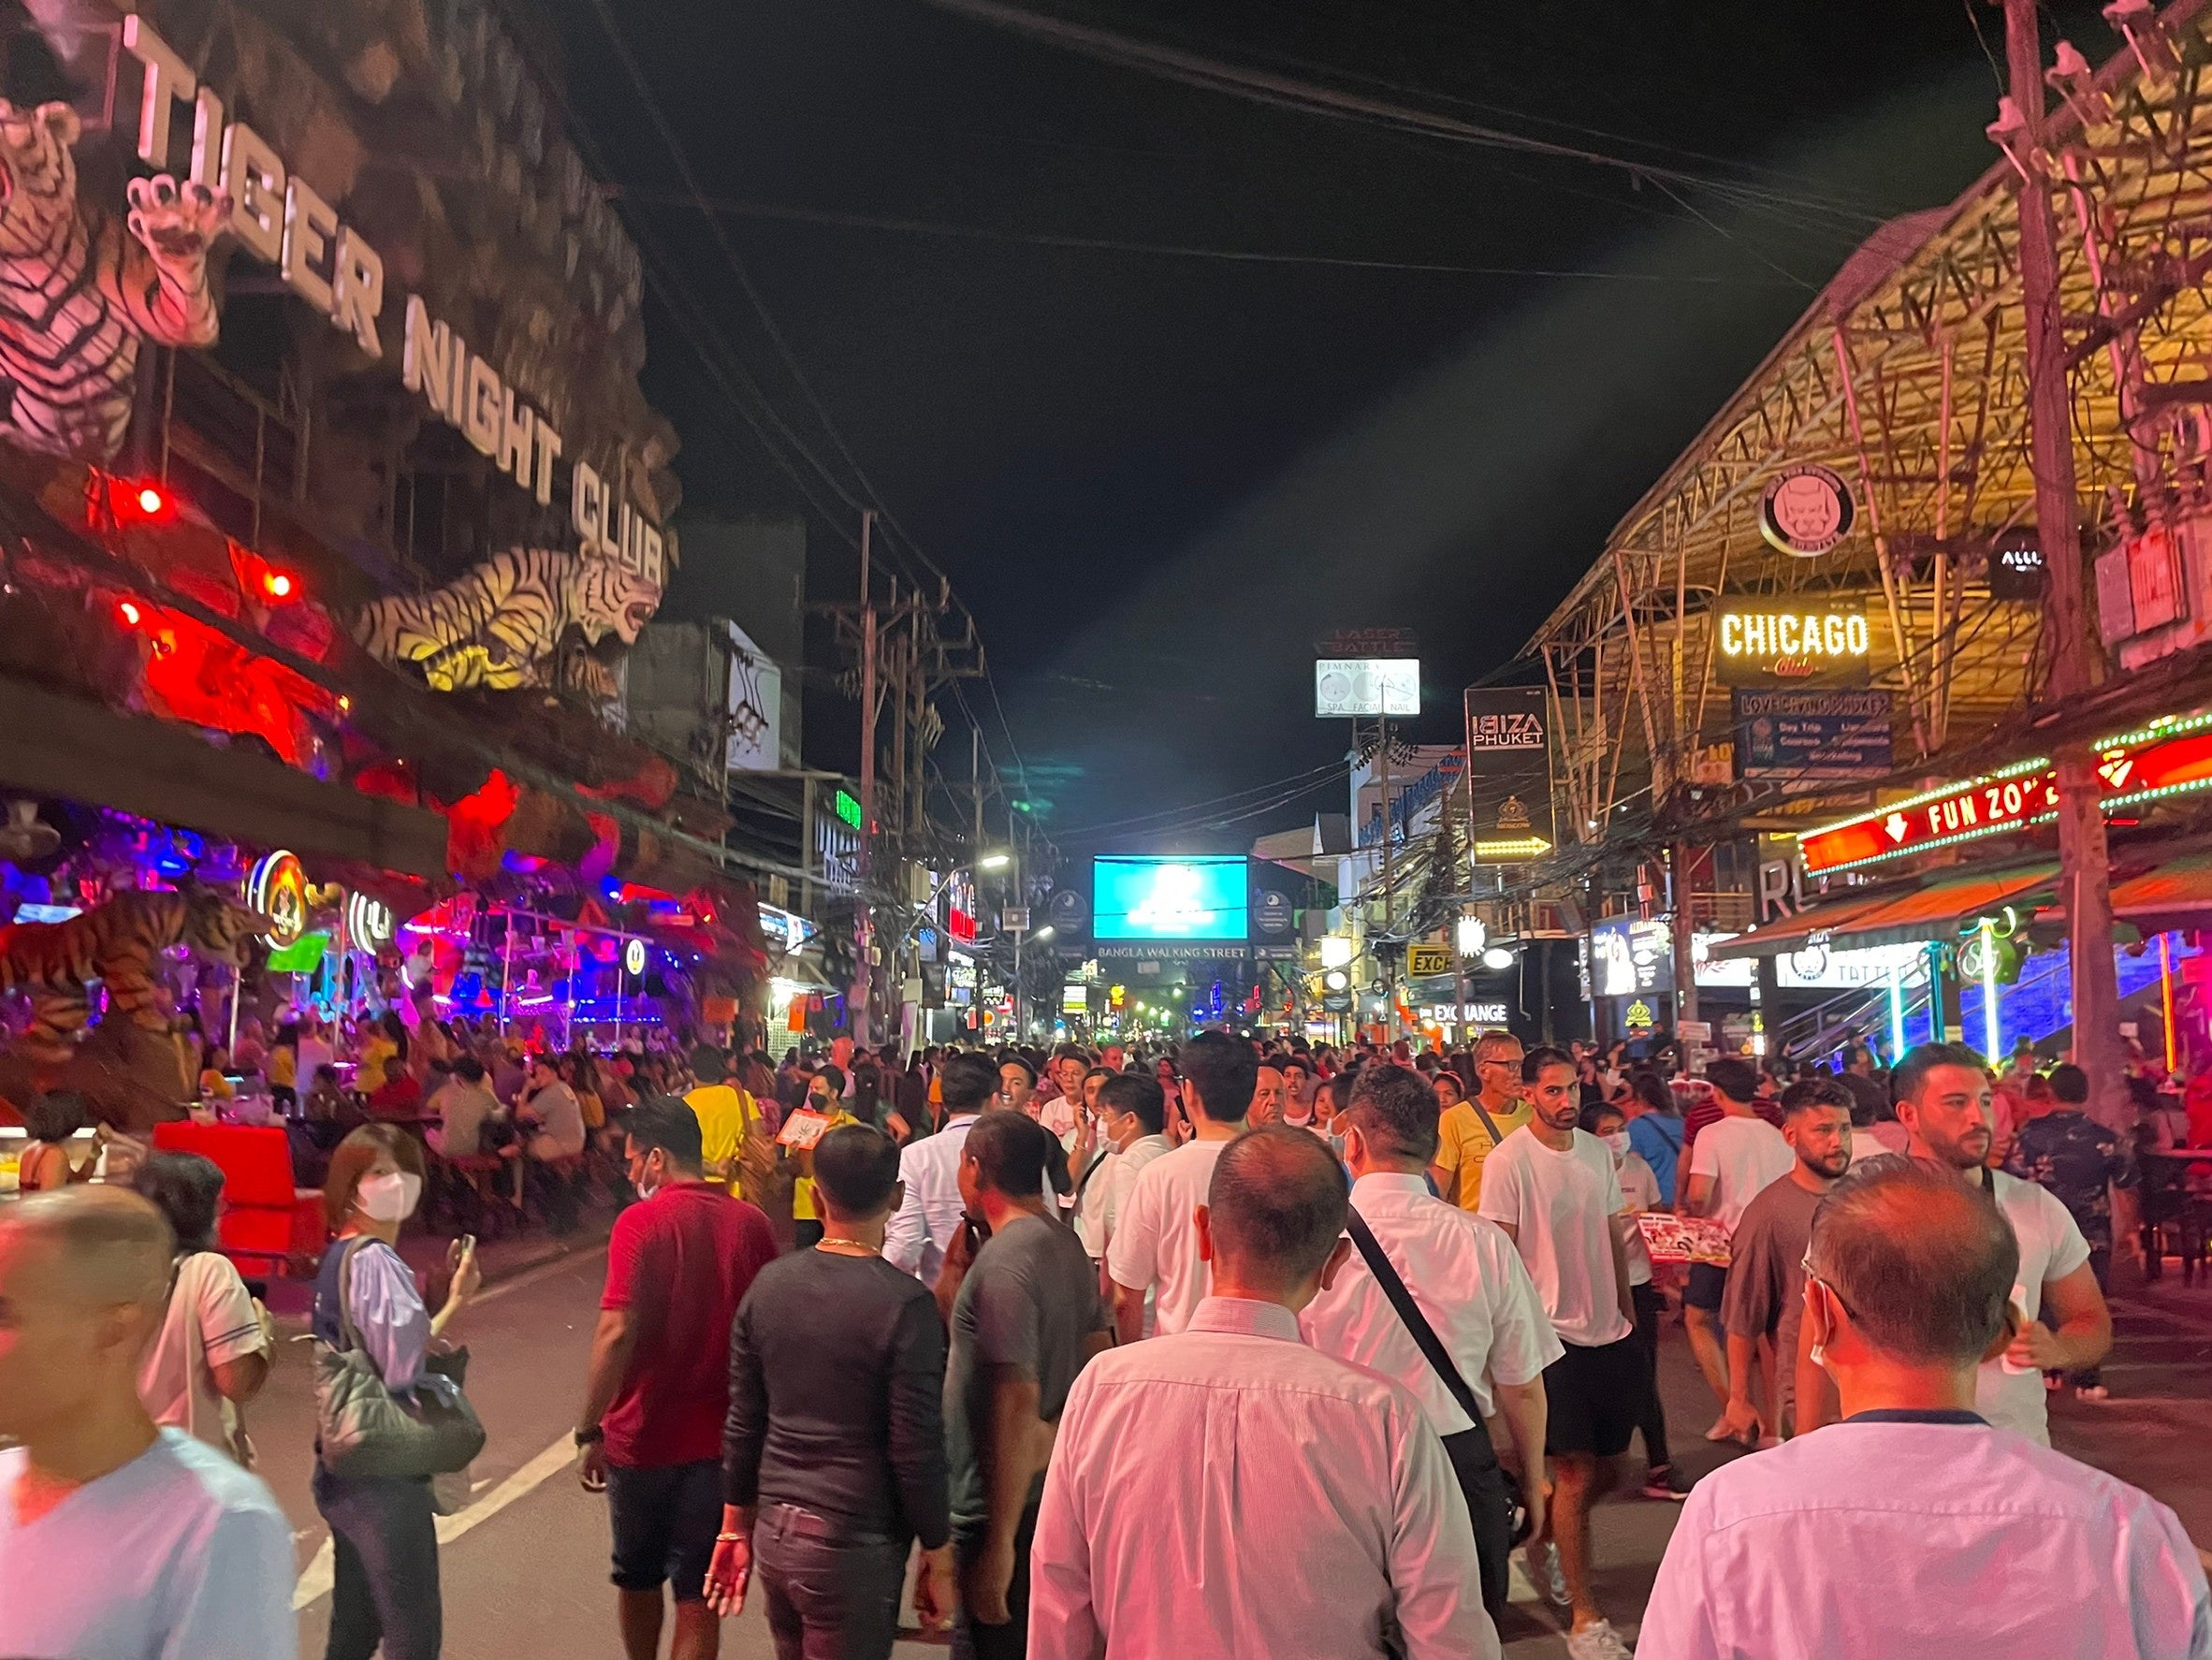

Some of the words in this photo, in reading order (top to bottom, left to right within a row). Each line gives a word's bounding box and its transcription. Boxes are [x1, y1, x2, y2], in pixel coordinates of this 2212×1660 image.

[124, 14, 383, 358] TIGER
[402, 293, 561, 507] NIGHT
[572, 459, 662, 588] CLUB
[1721, 614, 1869, 655] CHICAGO
[1327, 703, 1346, 712] SPA
[1390, 703, 1411, 712] NAIL
[1473, 713, 1544, 735] IBIZA
[1473, 733, 1543, 746] PHUKET
[1928, 794, 1978, 835] FUN
[1098, 948, 1144, 957] BANGLA
[1147, 948, 1201, 957] WALKING
[1203, 947, 1245, 957] STREET
